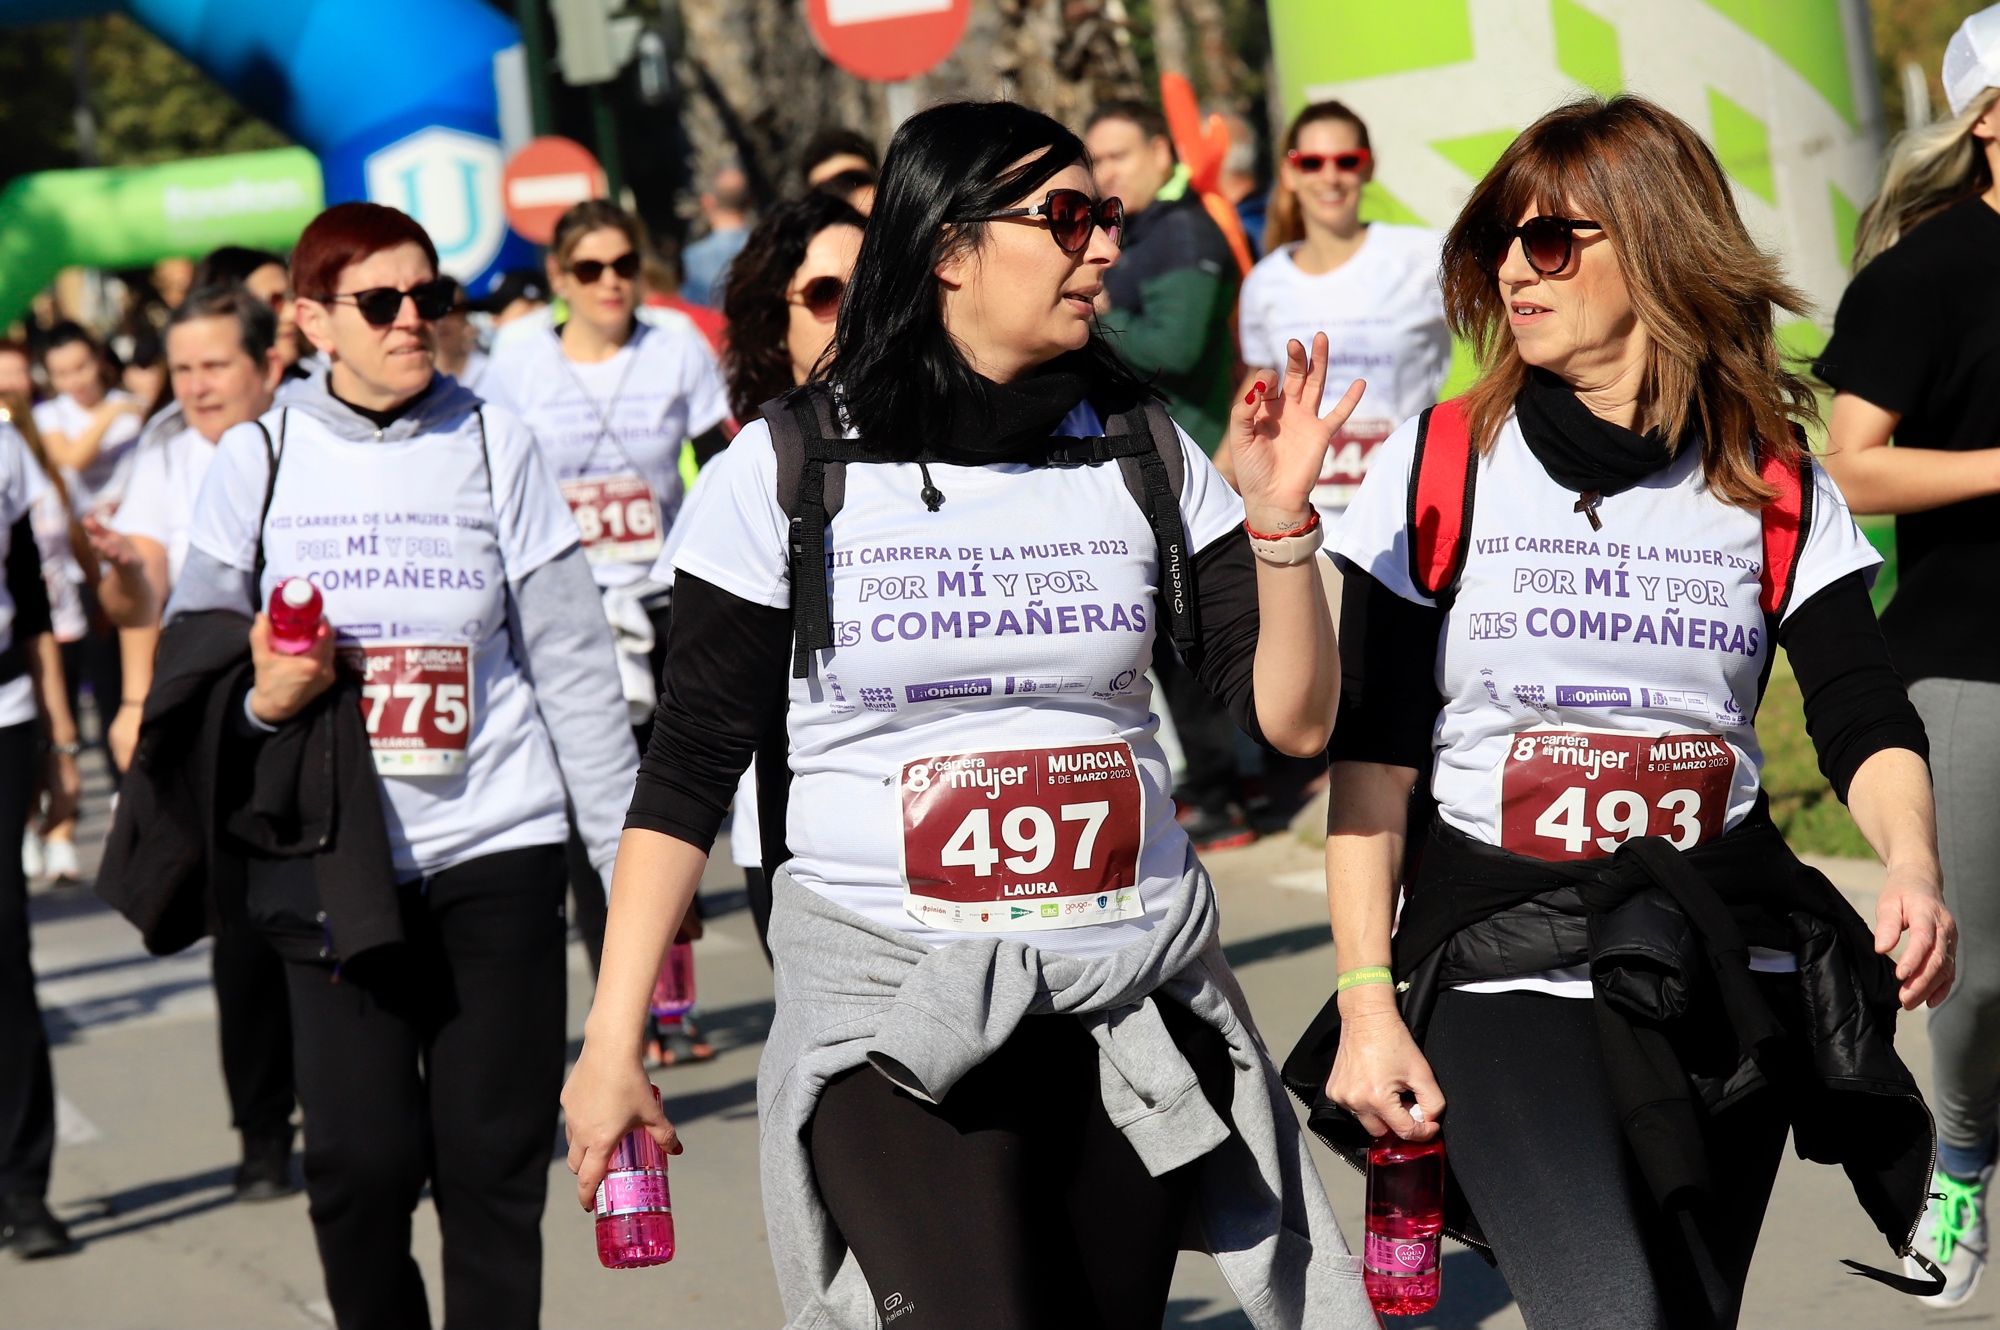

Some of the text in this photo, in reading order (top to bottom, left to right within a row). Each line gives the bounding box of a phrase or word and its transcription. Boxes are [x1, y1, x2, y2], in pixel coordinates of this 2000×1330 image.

[296, 513, 357, 527] CARRERA
[363, 512, 379, 525] DE
[385, 512, 401, 525] LA
[406, 513, 449, 526] MUJER
[296, 528, 453, 561] POR MÍ Y POR
[825, 540, 1129, 569] III CARRERA DE LA MUJER 2023
[1476, 536, 1510, 555] VIII
[1515, 536, 1601, 556] CARRERA
[1607, 543, 1631, 559] DE
[1637, 546, 1660, 562] LA
[1665, 548, 1730, 567] MUJER
[859, 563, 1099, 603] POR MÍ Y POR
[1169, 544, 1184, 615] Quechua
[1513, 561, 1729, 608] POR MÍ Y POR
[829, 600, 1147, 648] IS COMPAÑERAS
[1469, 607, 1760, 657] MIS COMPAÑERAS
[1541, 735, 1589, 748] carrera
[1649, 740, 1726, 762] MURCIA
[934, 757, 985, 772] carrera
[1048, 750, 1126, 773] MURCIA
[1048, 769, 1131, 785] 5 DE MARZO 2023
[1553, 745, 1630, 780] mujer
[1647, 757, 1729, 772] 5 DE MARZO 2023
[951, 765, 1028, 800] mujer
[1535, 786, 1702, 854] 493
[940, 800, 1110, 877] 497
[1004, 882, 1058, 897] LAURA
